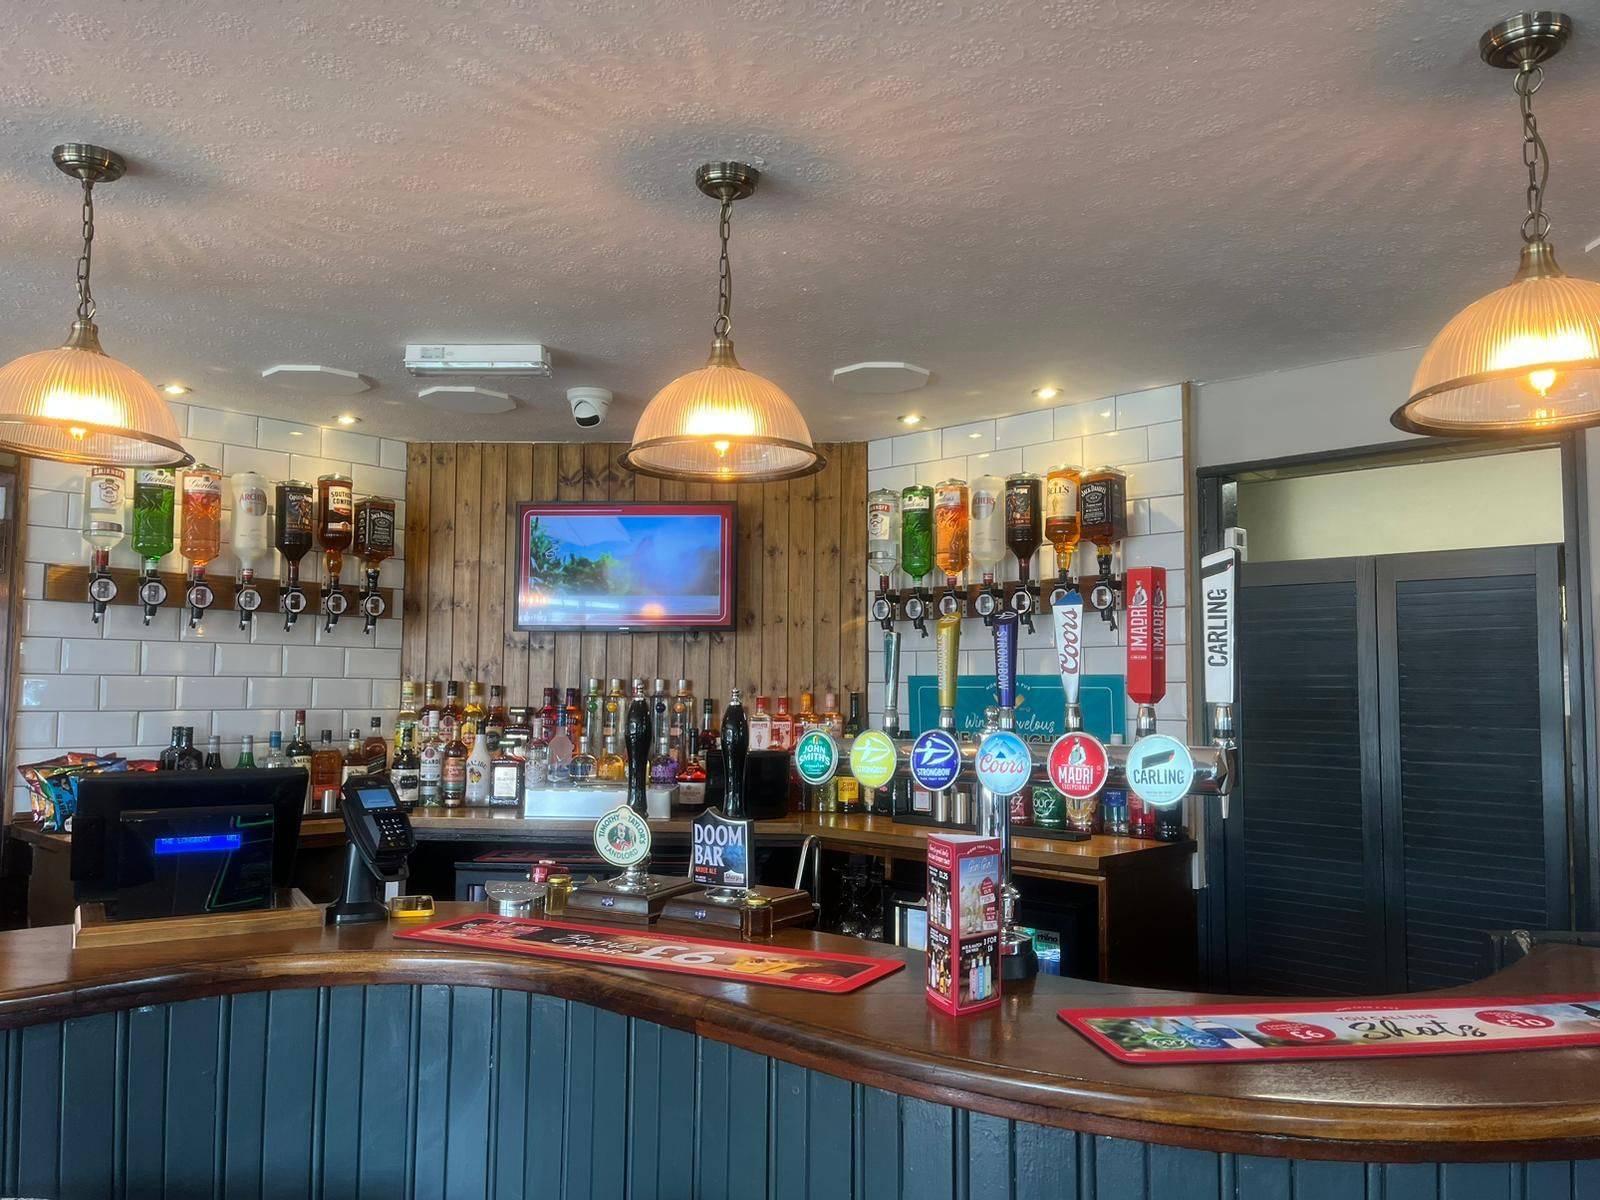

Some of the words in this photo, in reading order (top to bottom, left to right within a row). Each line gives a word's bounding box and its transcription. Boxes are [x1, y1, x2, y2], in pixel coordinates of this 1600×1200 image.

[1207, 588, 1229, 667] CARLING
[1060, 608, 1079, 674] Coors
[997, 631, 1009, 690] STRONGBOW
[804, 744, 826, 754] JOHN
[799, 752, 831, 767] SMITH'S
[979, 755, 1025, 774] Coors
[916, 767, 951, 776] STRONGBOW
[1133, 768, 1185, 785] CARLING
[599, 814, 621, 837] TIMOTHY
[627, 815, 647, 845] TAYLOR'S
[694, 824, 742, 845] DOOM
[604, 844, 639, 860] LANDLORD
[694, 844, 725, 866] BAR
[630, 945, 727, 965] £6
[1347, 1019, 1488, 1041] Shots
[1497, 1019, 1547, 1027] £10
[1289, 1029, 1326, 1040] £6
